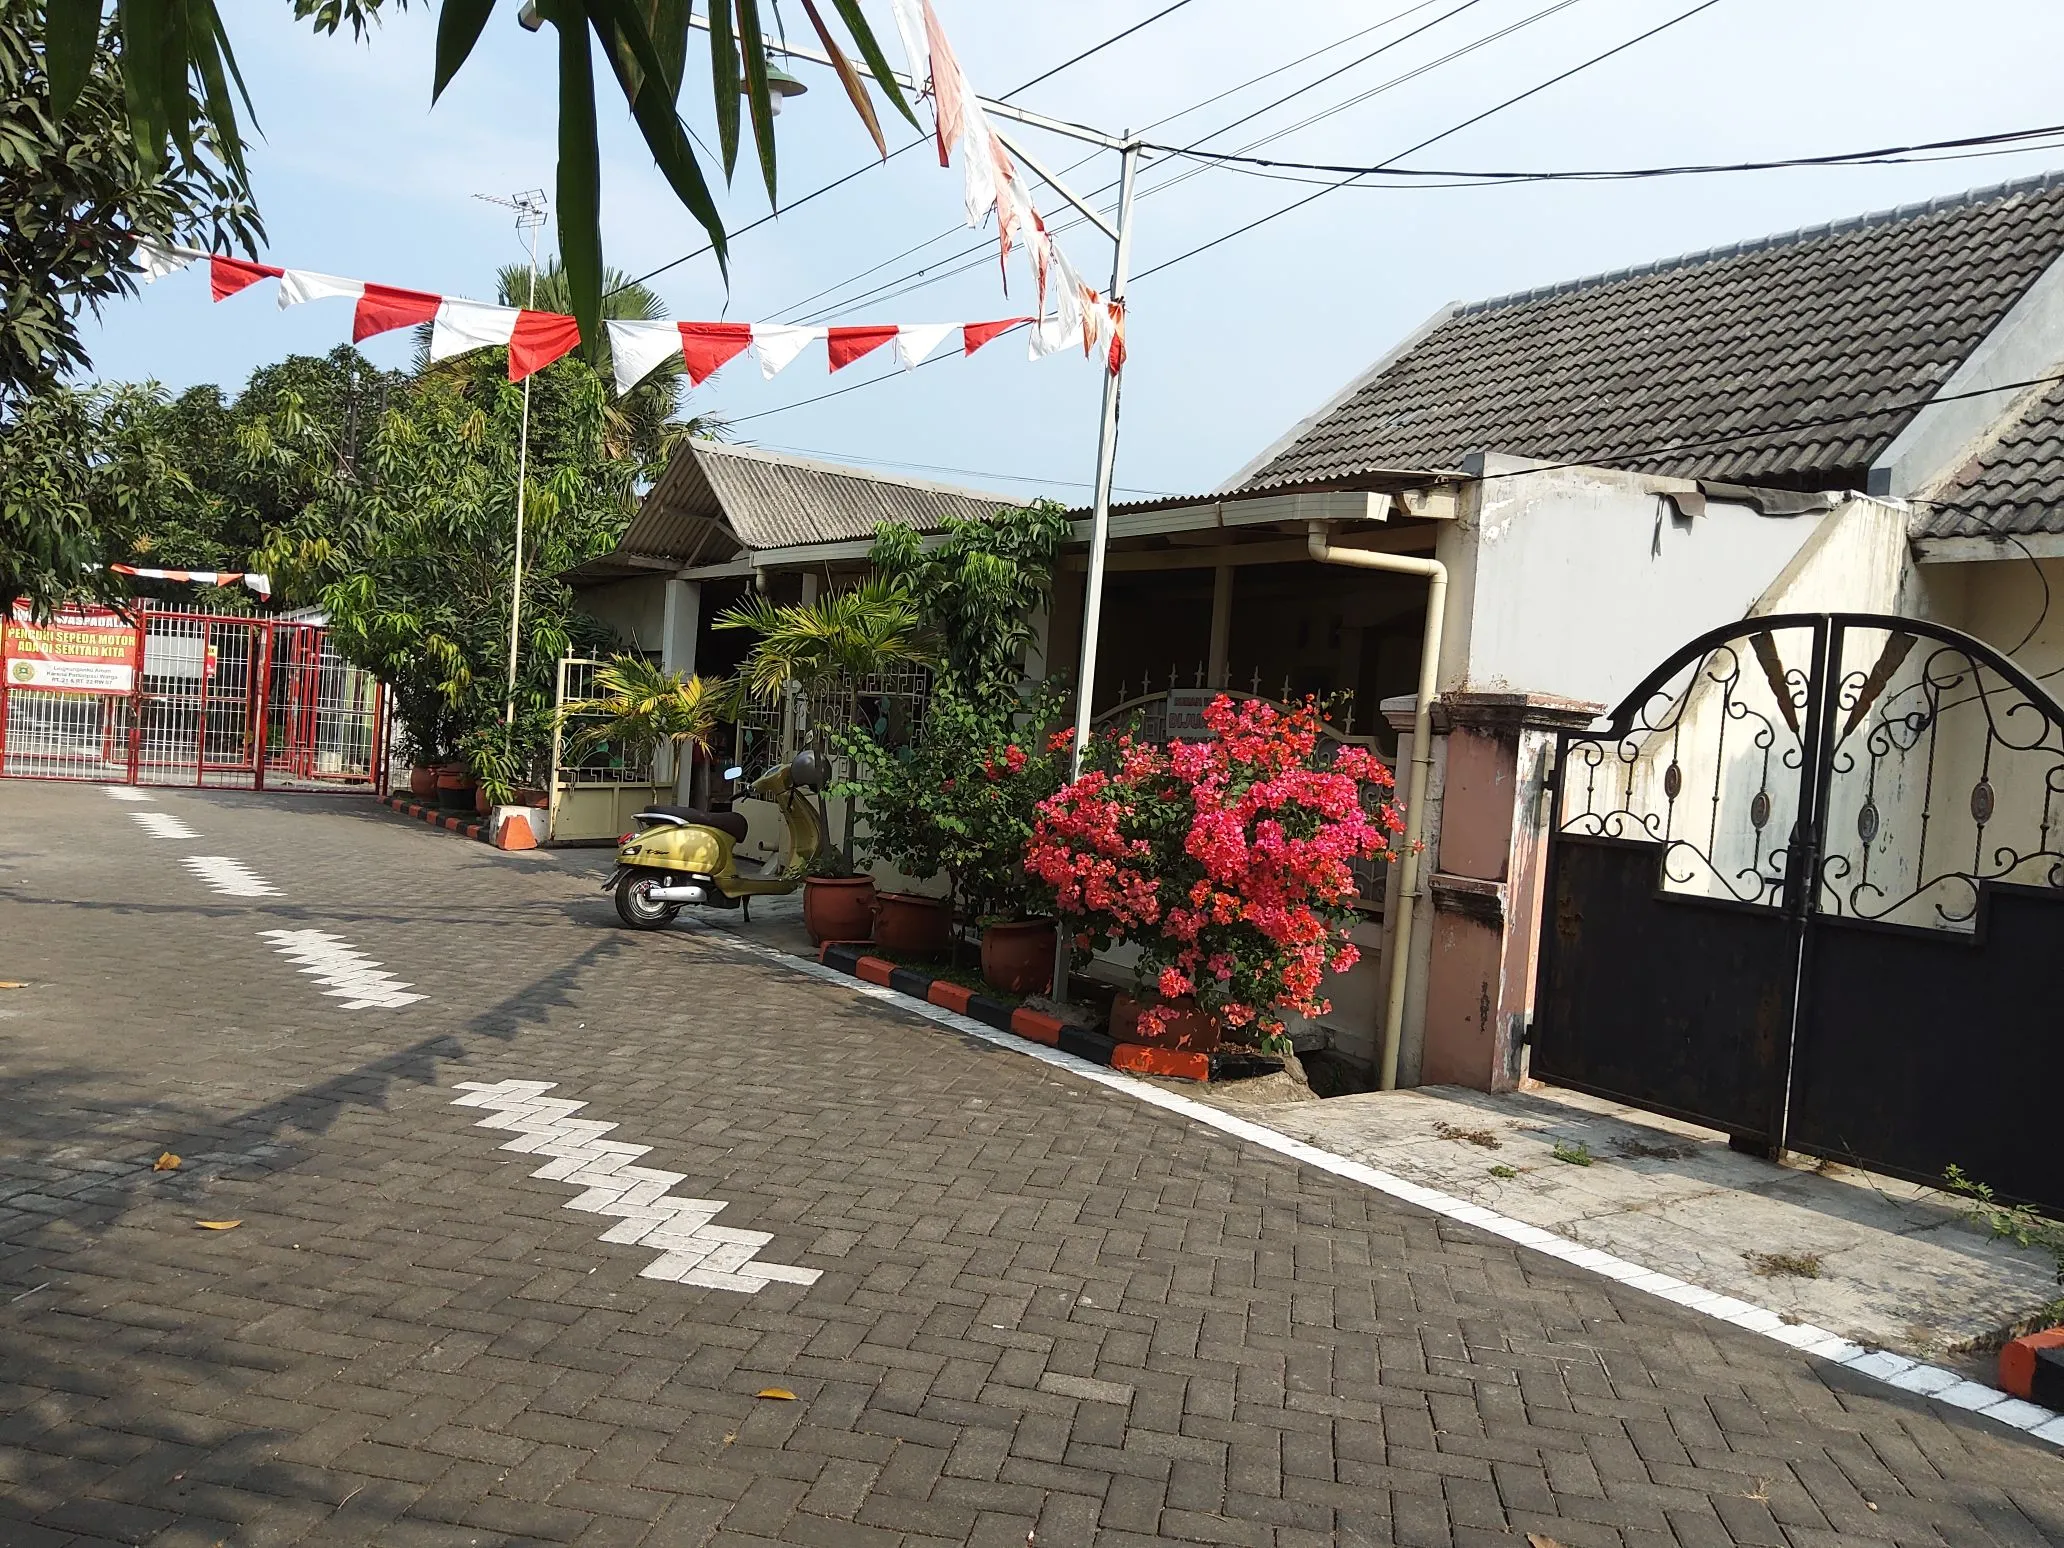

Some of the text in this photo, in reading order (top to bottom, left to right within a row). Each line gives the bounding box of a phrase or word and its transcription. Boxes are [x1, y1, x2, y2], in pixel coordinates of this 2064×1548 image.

[8, 627, 136, 646] PENCURI SEPEDA MOTOR
[18, 641, 125, 658] ADA DI SEKITAR KITA
